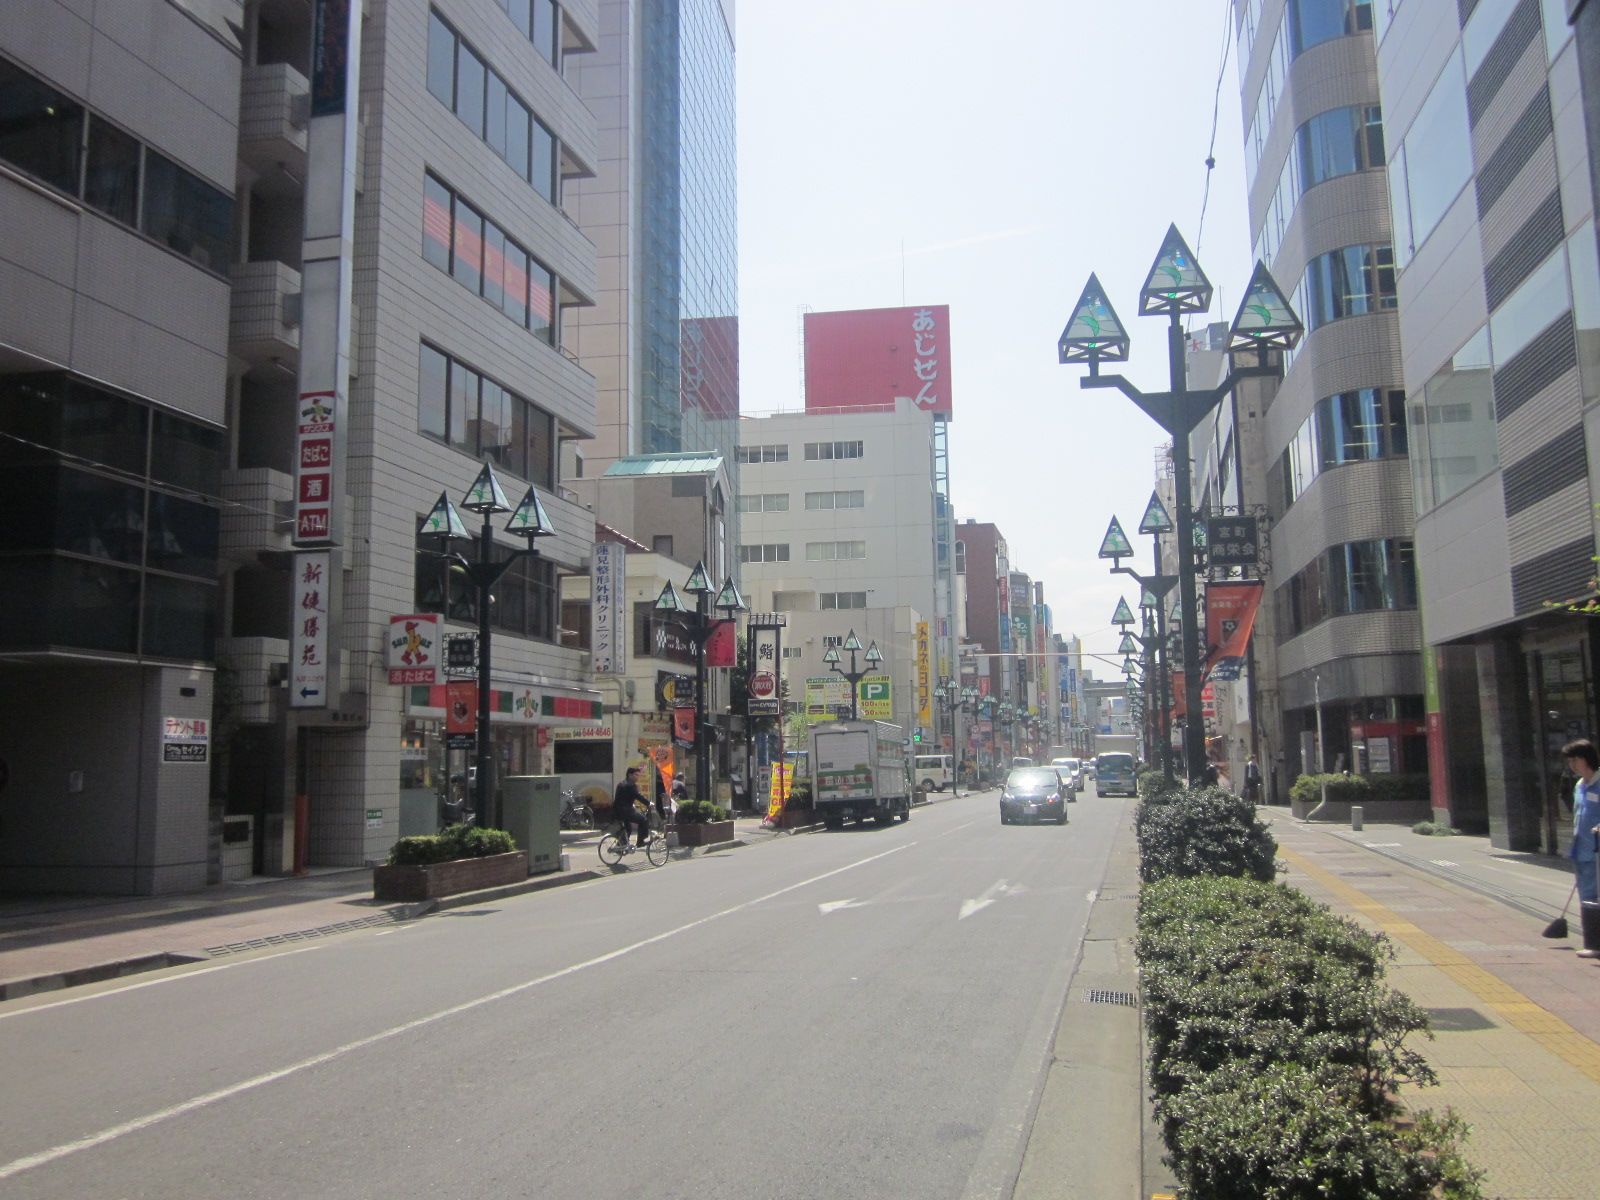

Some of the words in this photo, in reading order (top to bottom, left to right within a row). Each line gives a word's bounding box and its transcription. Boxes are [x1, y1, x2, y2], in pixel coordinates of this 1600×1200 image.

[911, 308, 938, 405] あじせん
[302, 445, 329, 463] たばこ
[306, 479, 322, 498] 酒
[300, 514, 327, 533] ATM
[595, 545, 610, 652] 蓮見整形外科クリニック
[758, 643, 774, 661] 鮨
[867, 683, 882, 699] P
